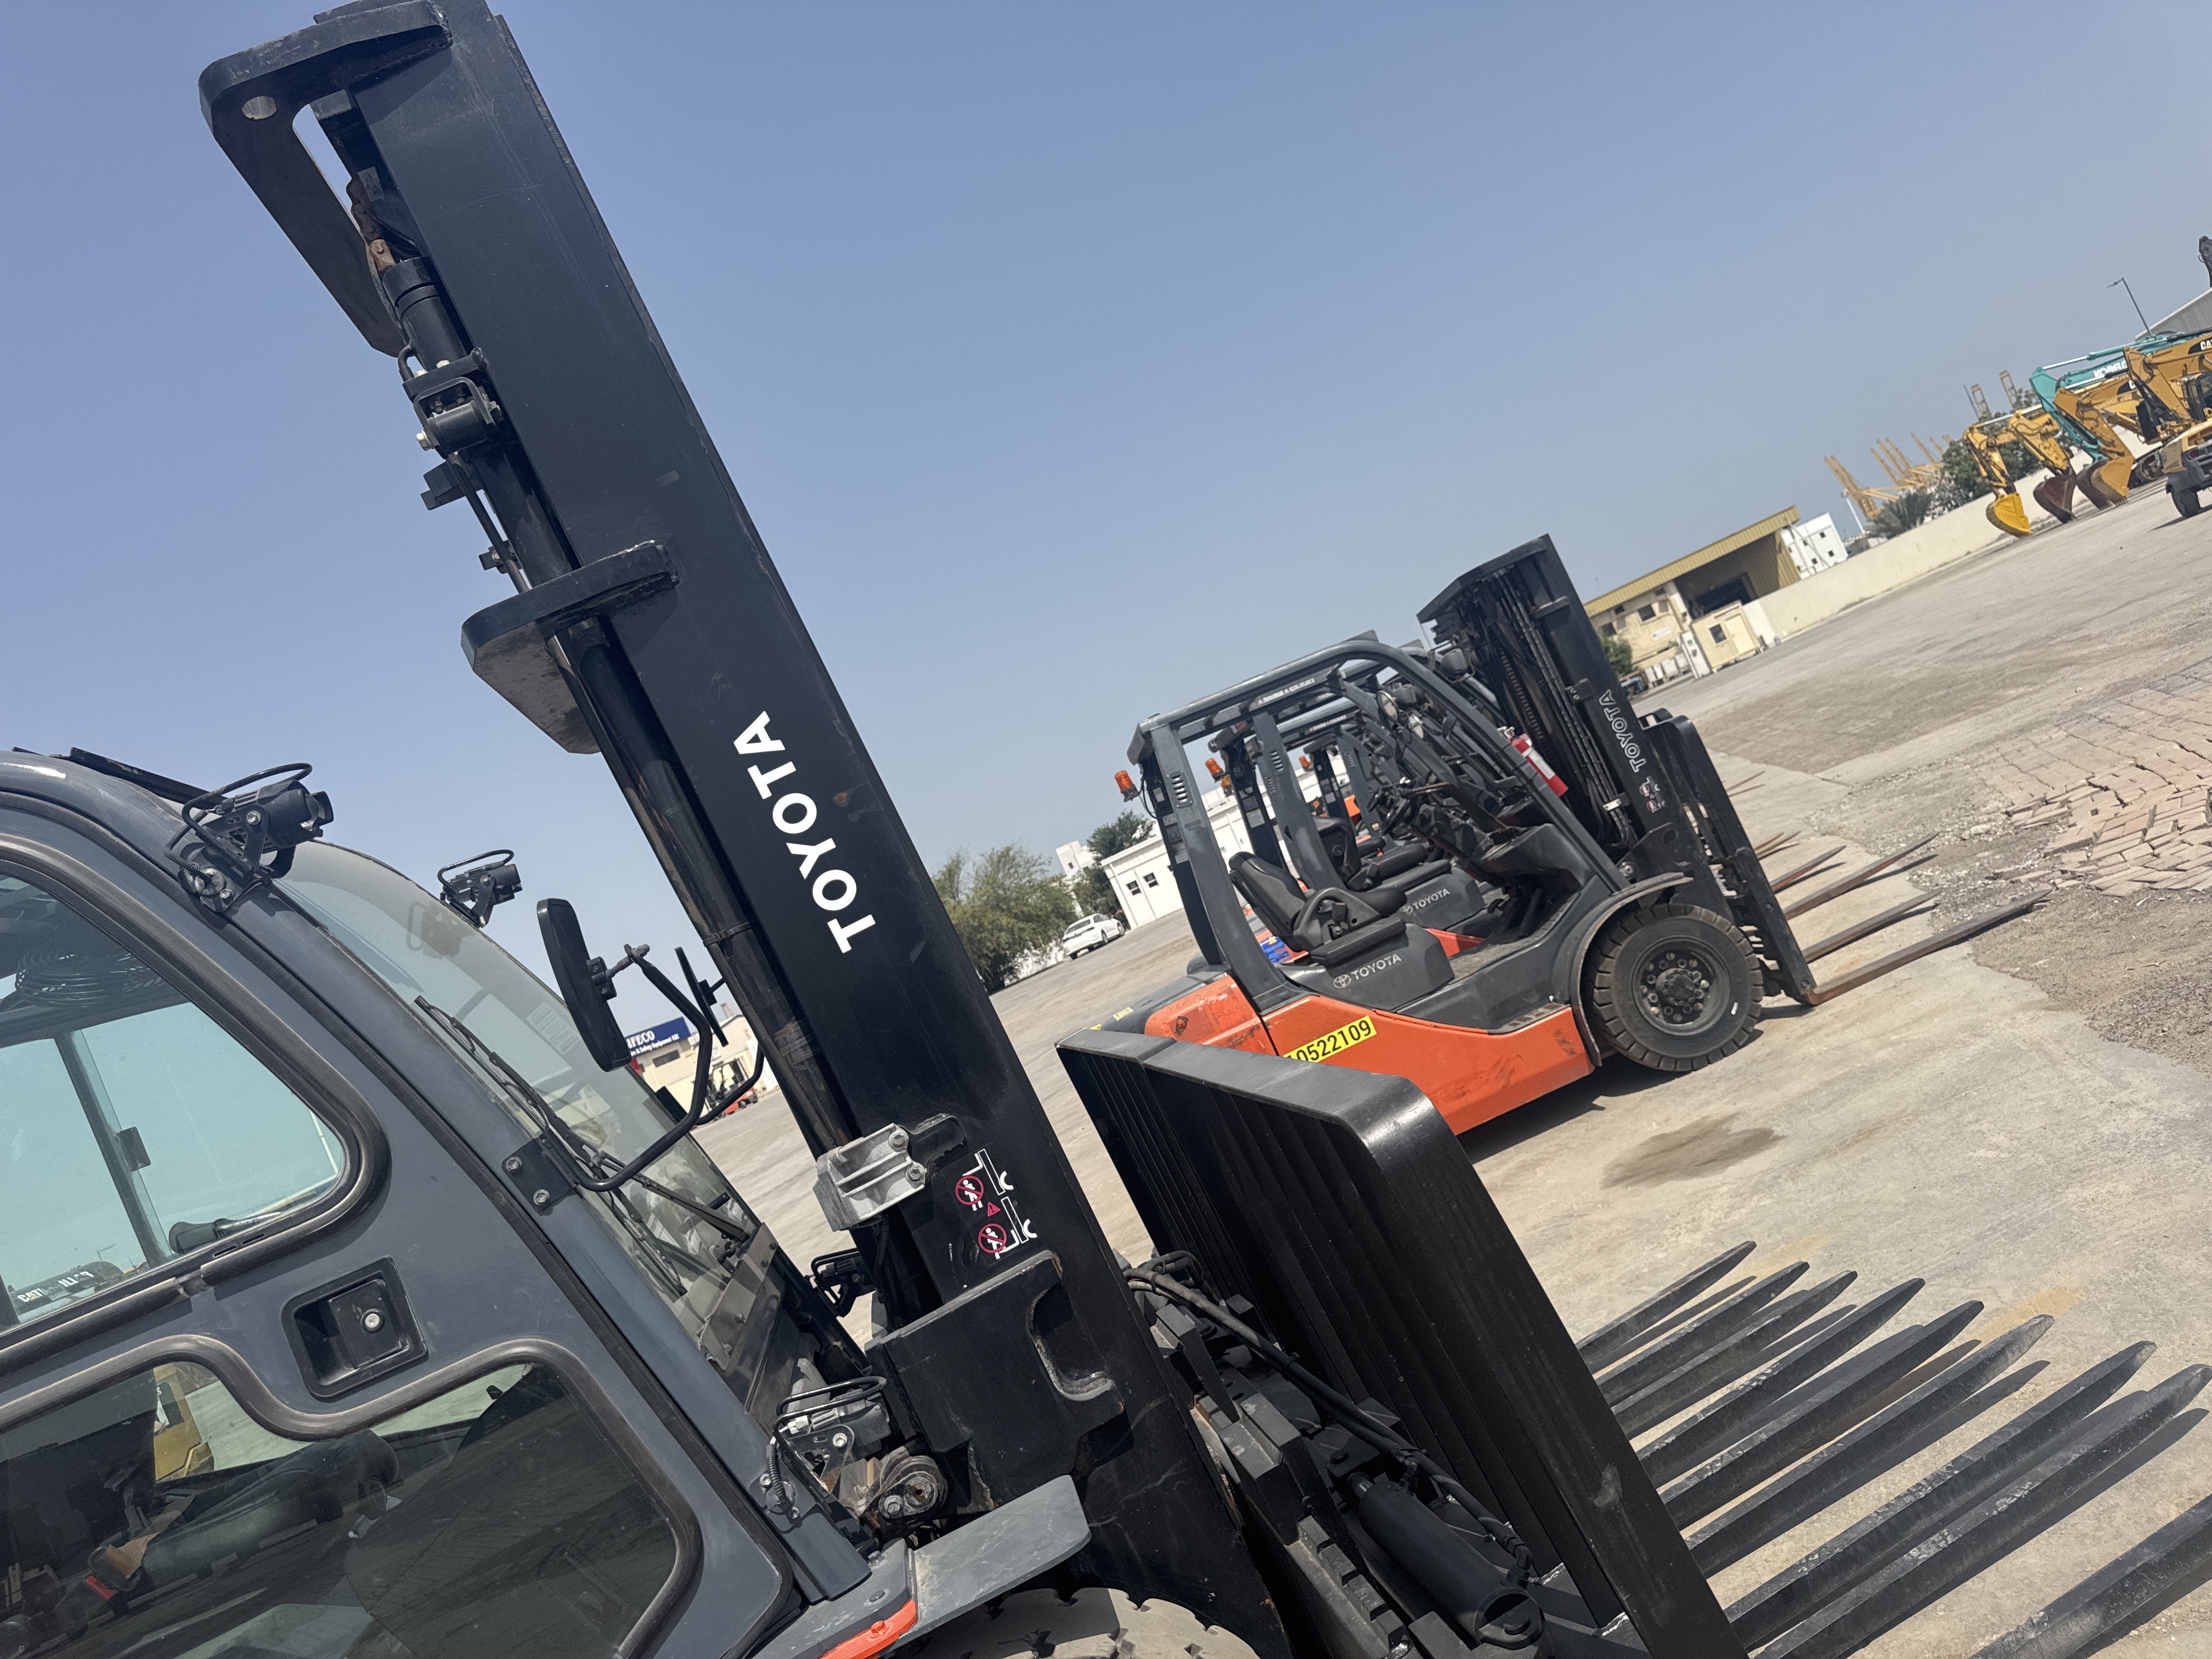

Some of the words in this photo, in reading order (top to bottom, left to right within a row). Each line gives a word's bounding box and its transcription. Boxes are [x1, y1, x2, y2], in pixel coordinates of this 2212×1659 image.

[1599, 689, 1647, 773] TOYOTA
[733, 710, 876, 953] TOYOTA
[1412, 888, 1451, 910] TOYOTA
[1350, 953, 1402, 980] TOYOTA
[626, 1030, 655, 1049] IFECO
[1287, 1020, 1371, 1061] 0522109
